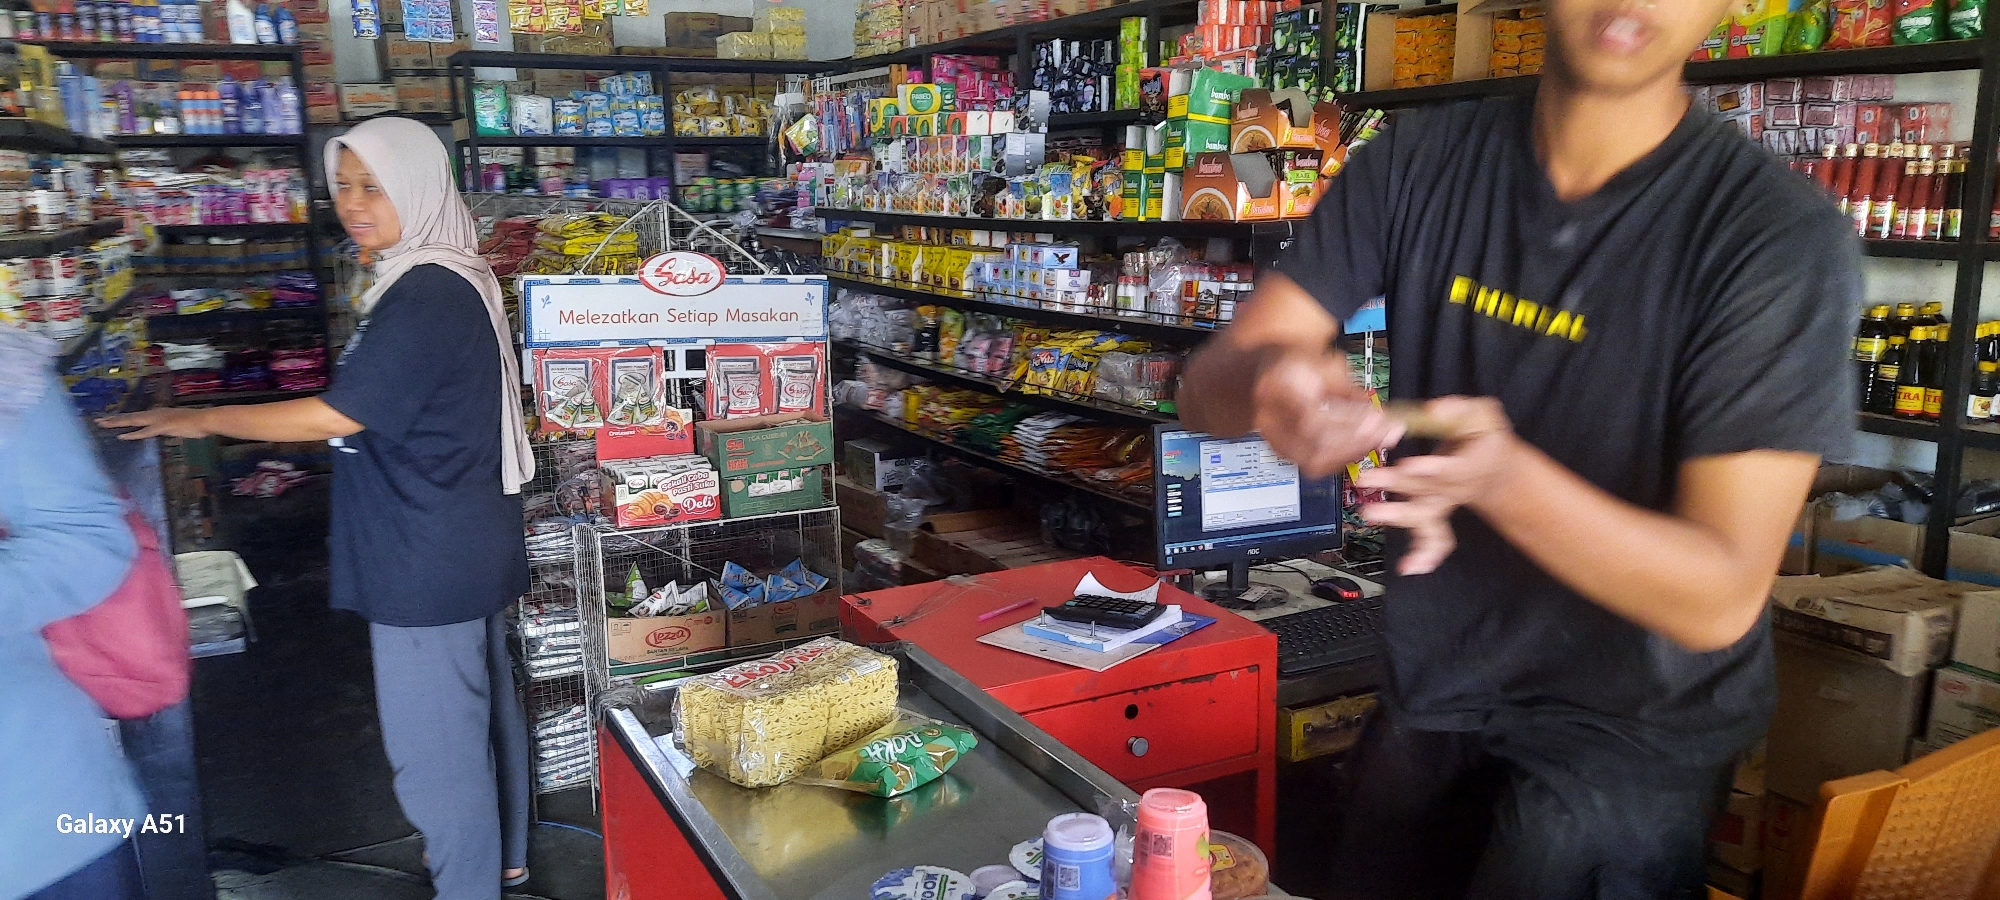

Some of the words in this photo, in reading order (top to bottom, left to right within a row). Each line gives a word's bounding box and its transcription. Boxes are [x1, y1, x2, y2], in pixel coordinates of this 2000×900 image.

[654, 257, 713, 286] Sasa
[558, 308, 659, 325] Melezatkan
[666, 307, 718, 327] Setiap
[725, 307, 799, 323] Masakan
[661, 476, 688, 491] Sekali
[688, 471, 709, 483] Coba
[694, 479, 715, 490] Suka
[683, 494, 714, 511] Deli
[653, 629, 685, 644] Lezza
